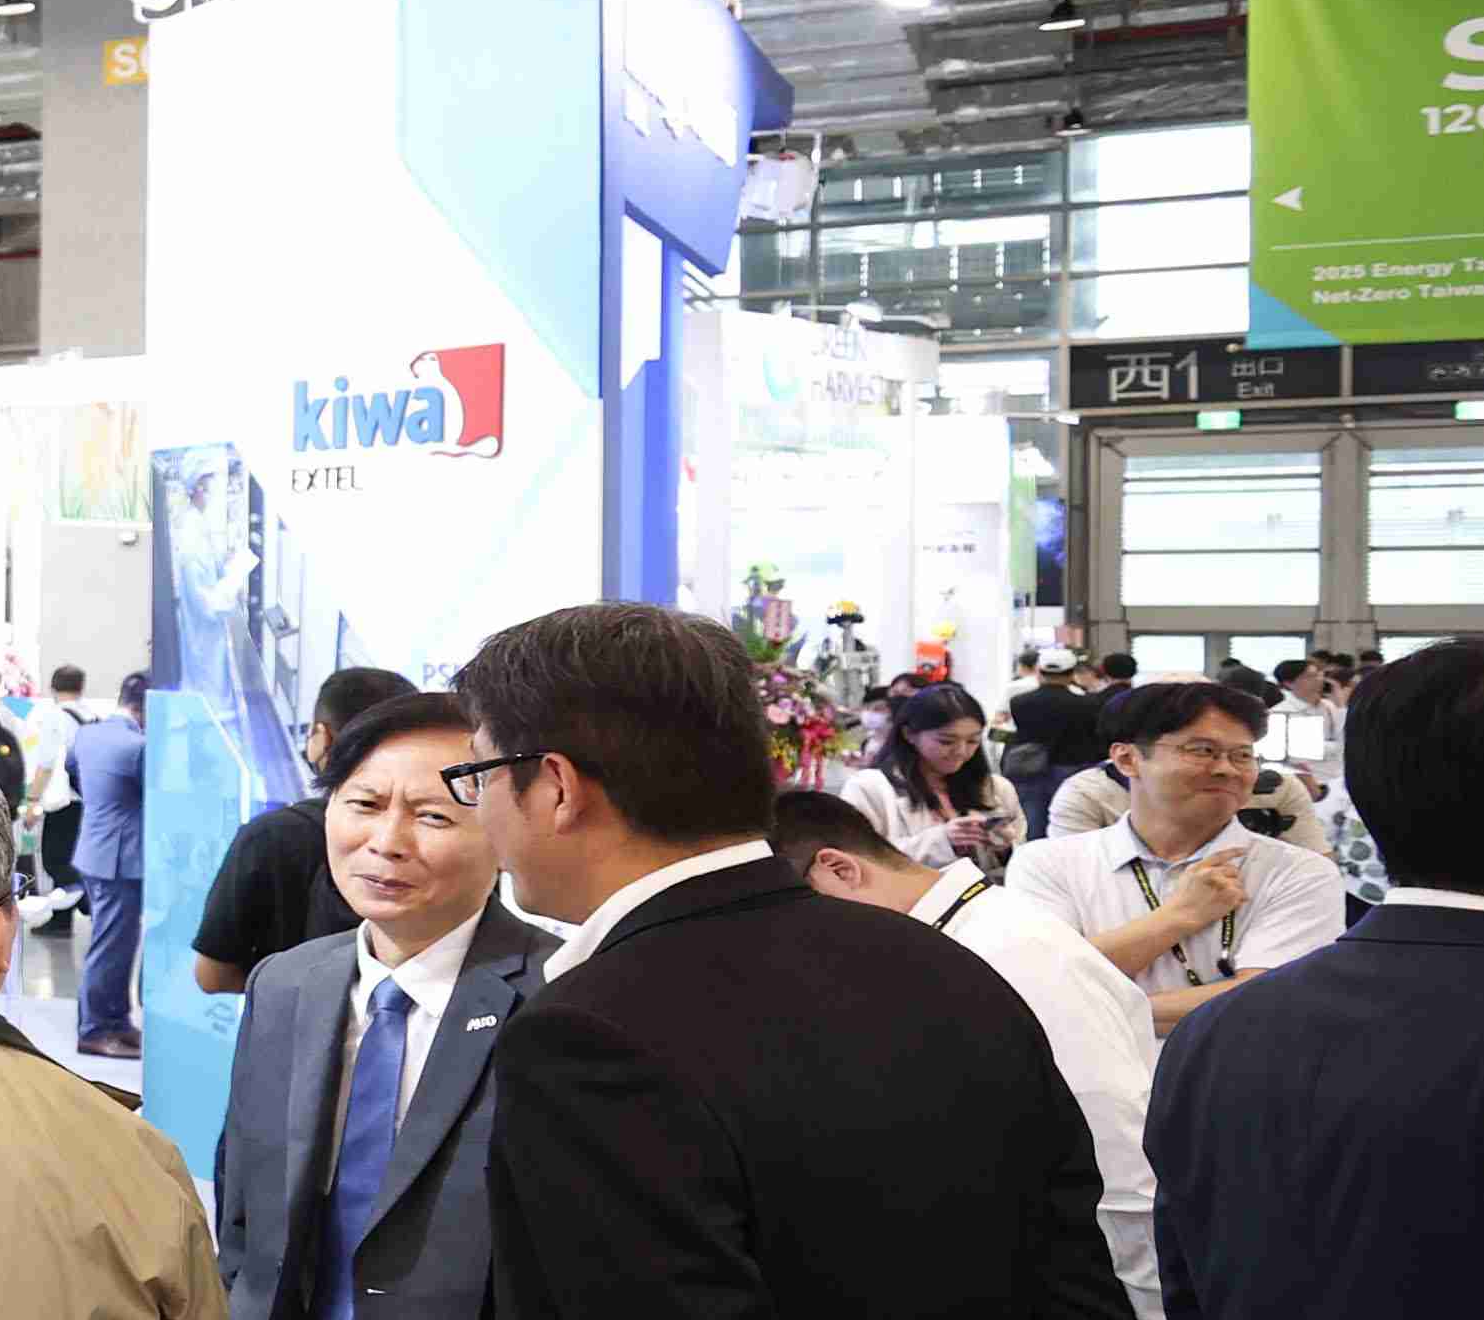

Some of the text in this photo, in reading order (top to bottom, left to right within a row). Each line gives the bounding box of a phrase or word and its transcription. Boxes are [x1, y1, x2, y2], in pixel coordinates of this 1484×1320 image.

[111, 44, 148, 79] S
[1230, 357, 1284, 377] 出口
[1236, 381, 1275, 397] Exit
[292, 375, 445, 452] kiwa
